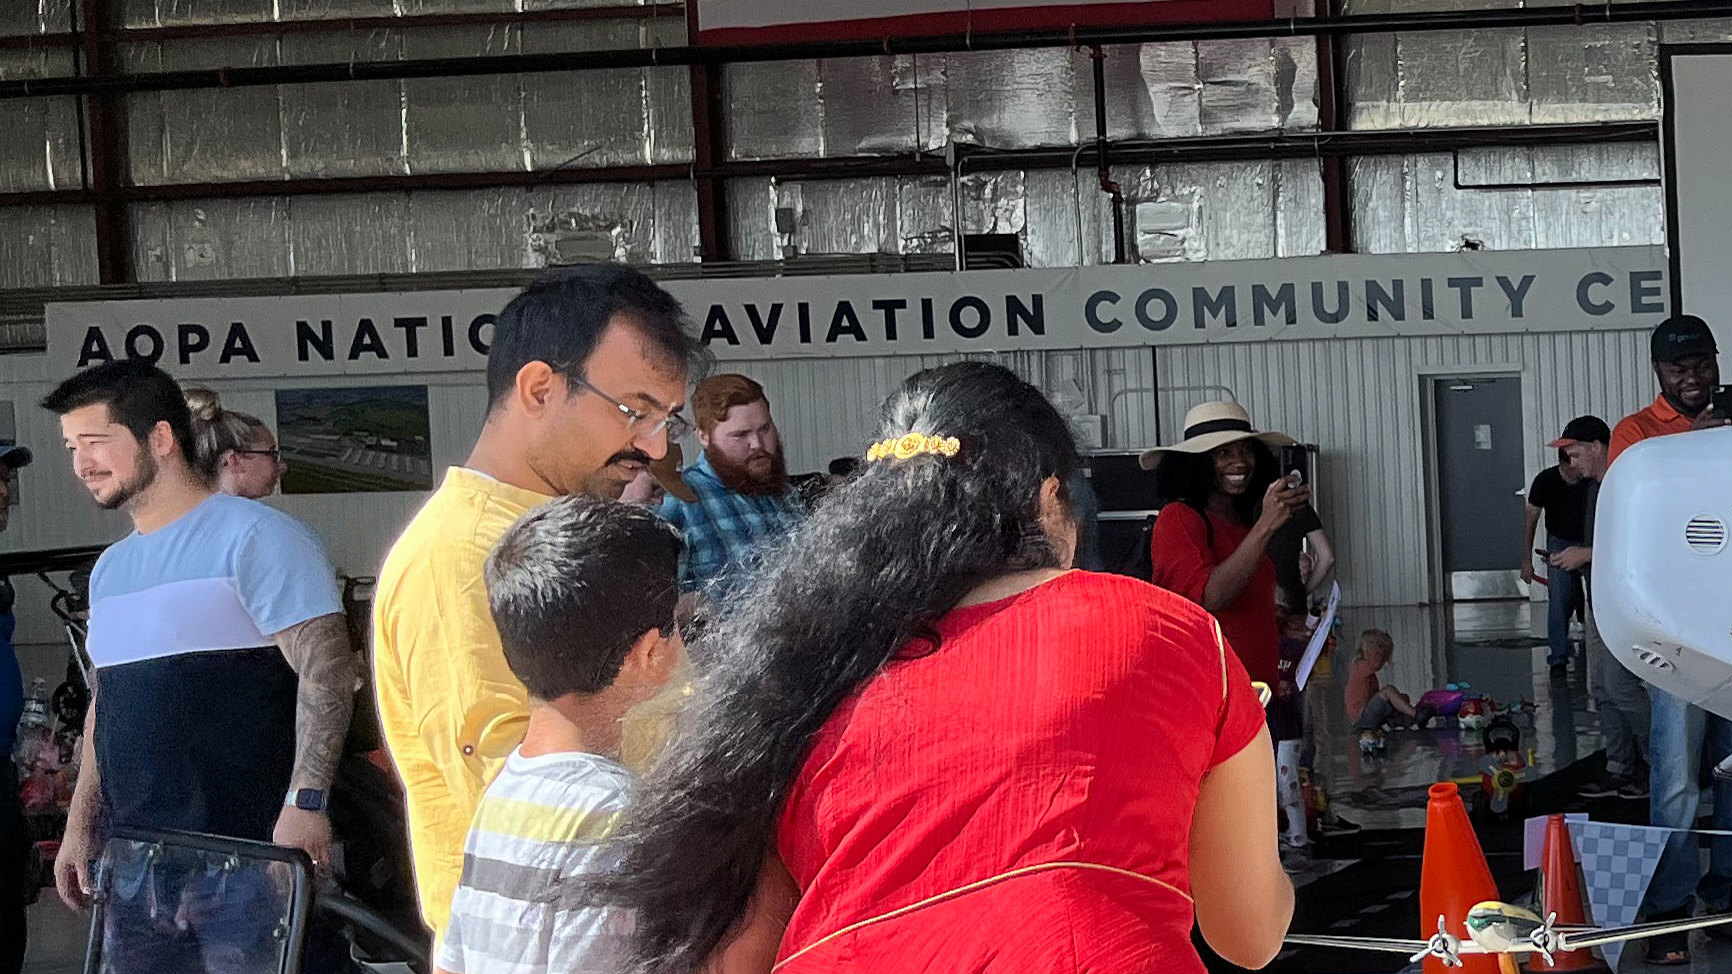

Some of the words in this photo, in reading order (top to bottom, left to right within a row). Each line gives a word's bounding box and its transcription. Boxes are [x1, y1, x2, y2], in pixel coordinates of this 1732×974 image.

[76, 322, 261, 368] AOPA
[700, 293, 1046, 346] AVIATION
[1085, 274, 1537, 334] COMMUNITY
[1575, 270, 1665, 317] CE
